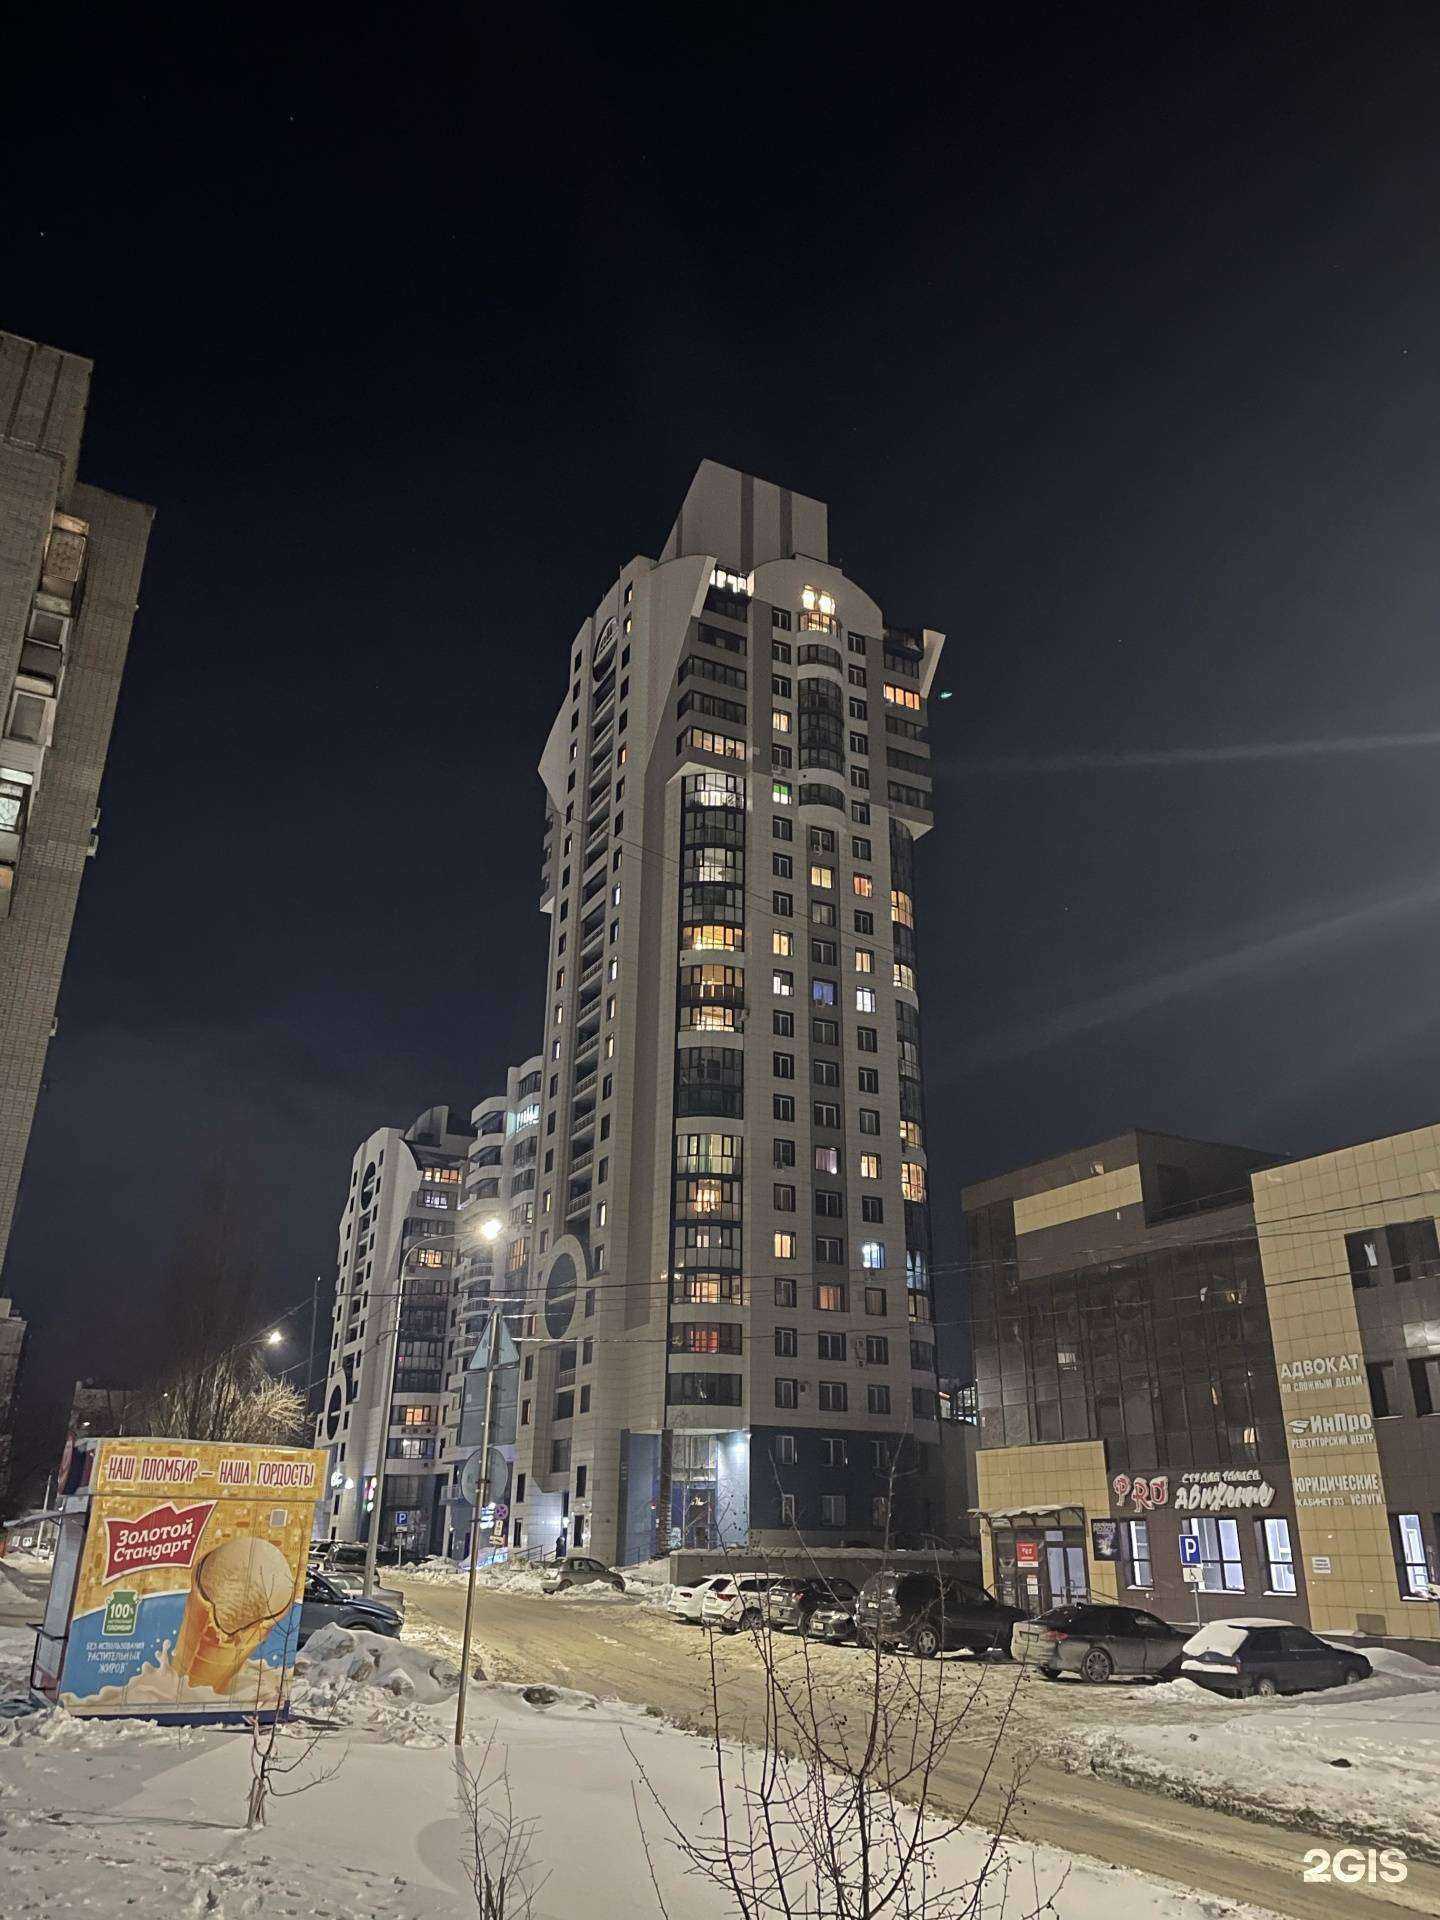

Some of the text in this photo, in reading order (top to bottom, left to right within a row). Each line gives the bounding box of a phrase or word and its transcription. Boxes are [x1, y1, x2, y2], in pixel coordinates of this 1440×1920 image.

[1281, 1353, 1359, 1379] АДВОКАТ
[1335, 1375, 1363, 1388] ДЕЛАМ
[1310, 1413, 1372, 1433] ИнПро
[1350, 1433, 1374, 1446] ЦЕНТР
[108, 1457, 136, 1481] НАШ
[140, 1458, 199, 1483] ПЛОМБИР
[219, 1461, 251, 1484] НАША
[256, 1462, 315, 1487] ГОРДОСТЬ!
[1294, 1473, 1379, 1494] ЮРИДИЧЕСКИЕ
[1350, 1494, 1383, 1505] УСЛУГИ
[1184, 1538, 1197, 1561] P
